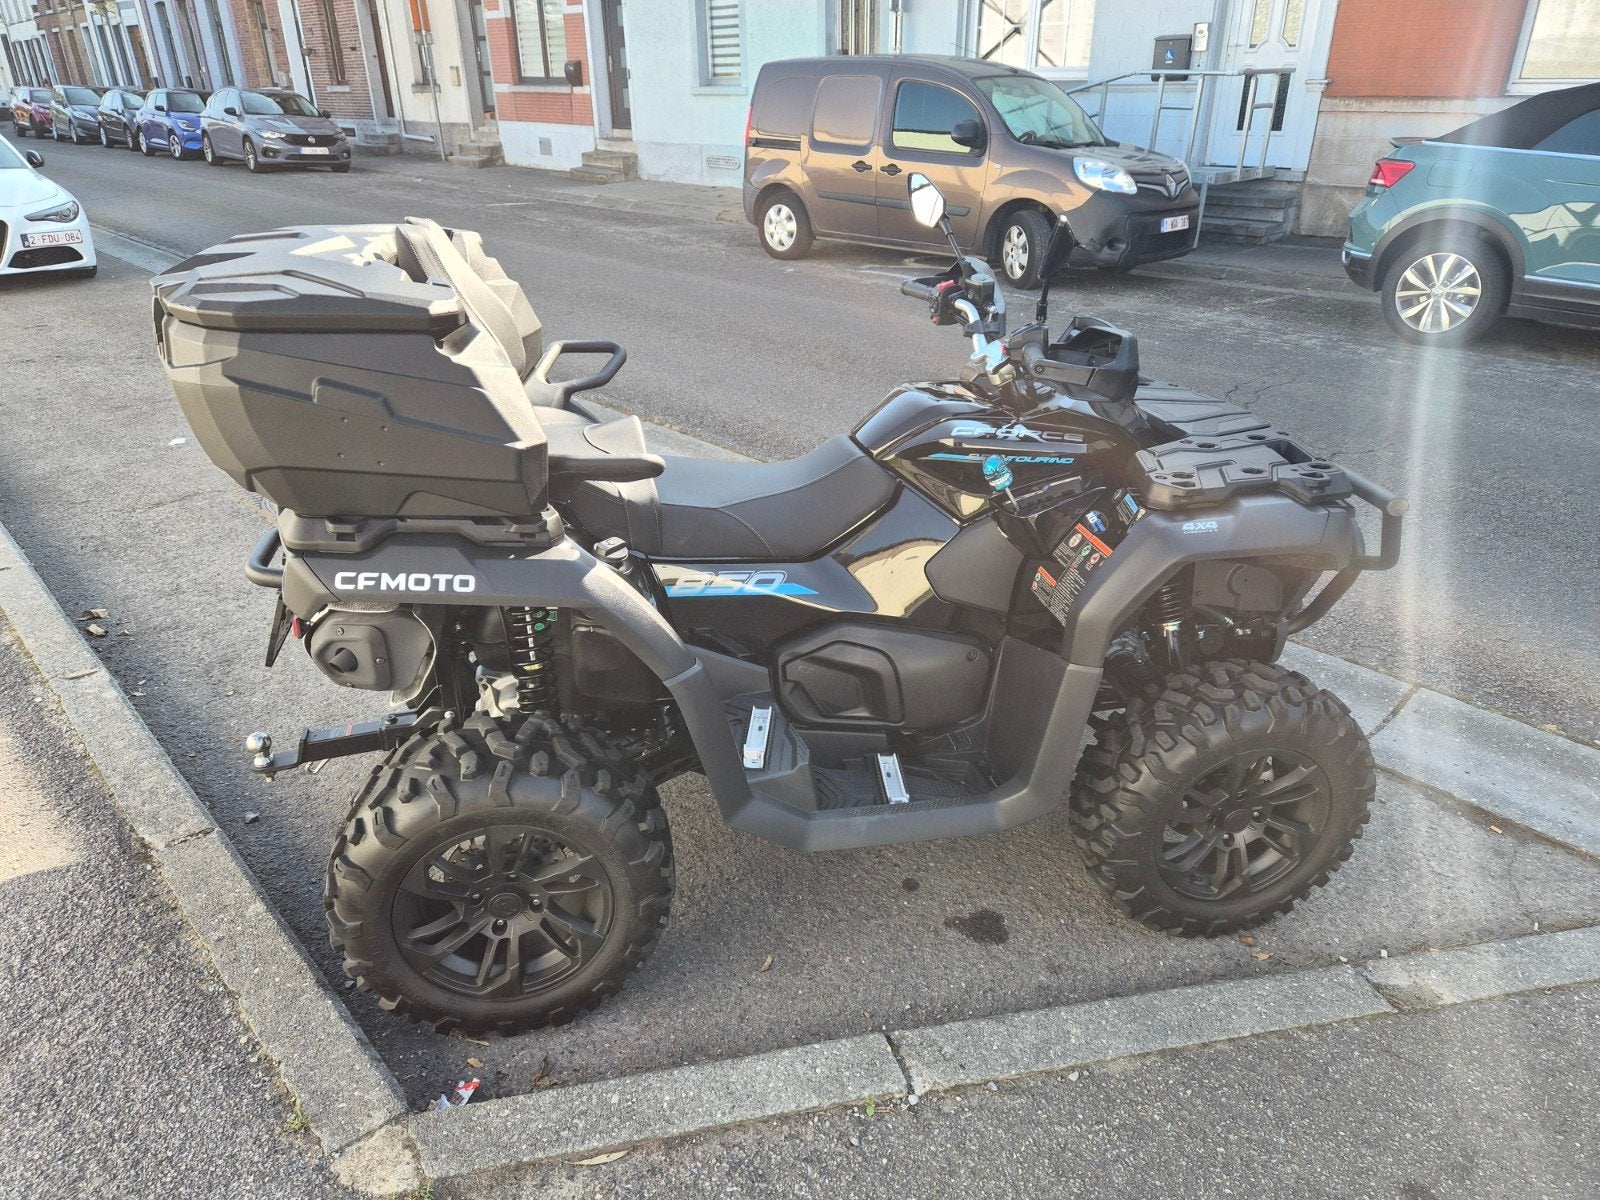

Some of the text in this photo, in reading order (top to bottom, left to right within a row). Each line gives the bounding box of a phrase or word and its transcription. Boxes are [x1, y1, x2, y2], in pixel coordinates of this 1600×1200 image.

[1007, 455, 1075, 464] TOURING
[334, 571, 476, 593] CFMOTO
[672, 570, 788, 594] 850
